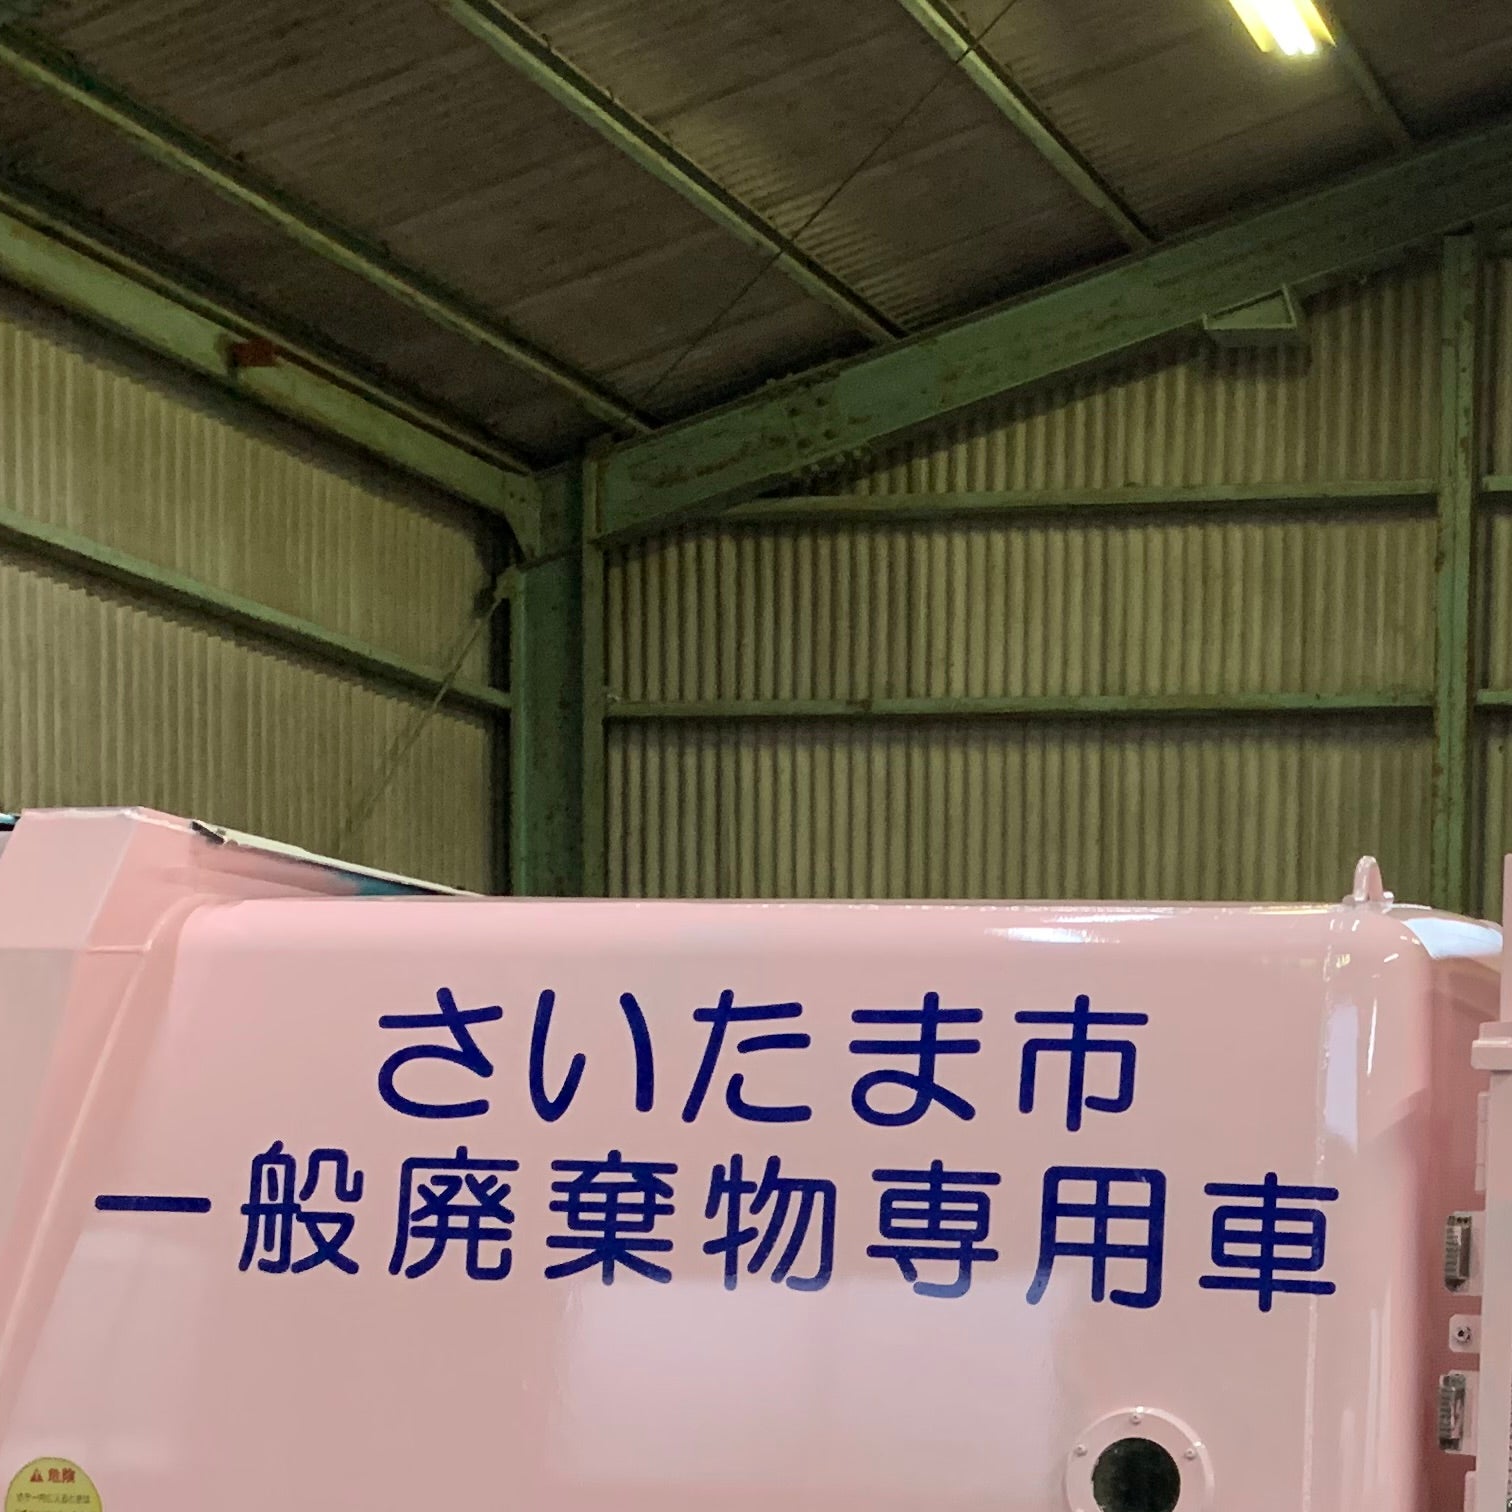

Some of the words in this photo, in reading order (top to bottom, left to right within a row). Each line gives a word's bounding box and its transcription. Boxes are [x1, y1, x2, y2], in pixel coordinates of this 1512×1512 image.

[377, 986, 1149, 1132] さいたま市
[94, 1140, 1340, 1313] 一般廃棄物専用車
[47, 1468, 76, 1484] 危険
